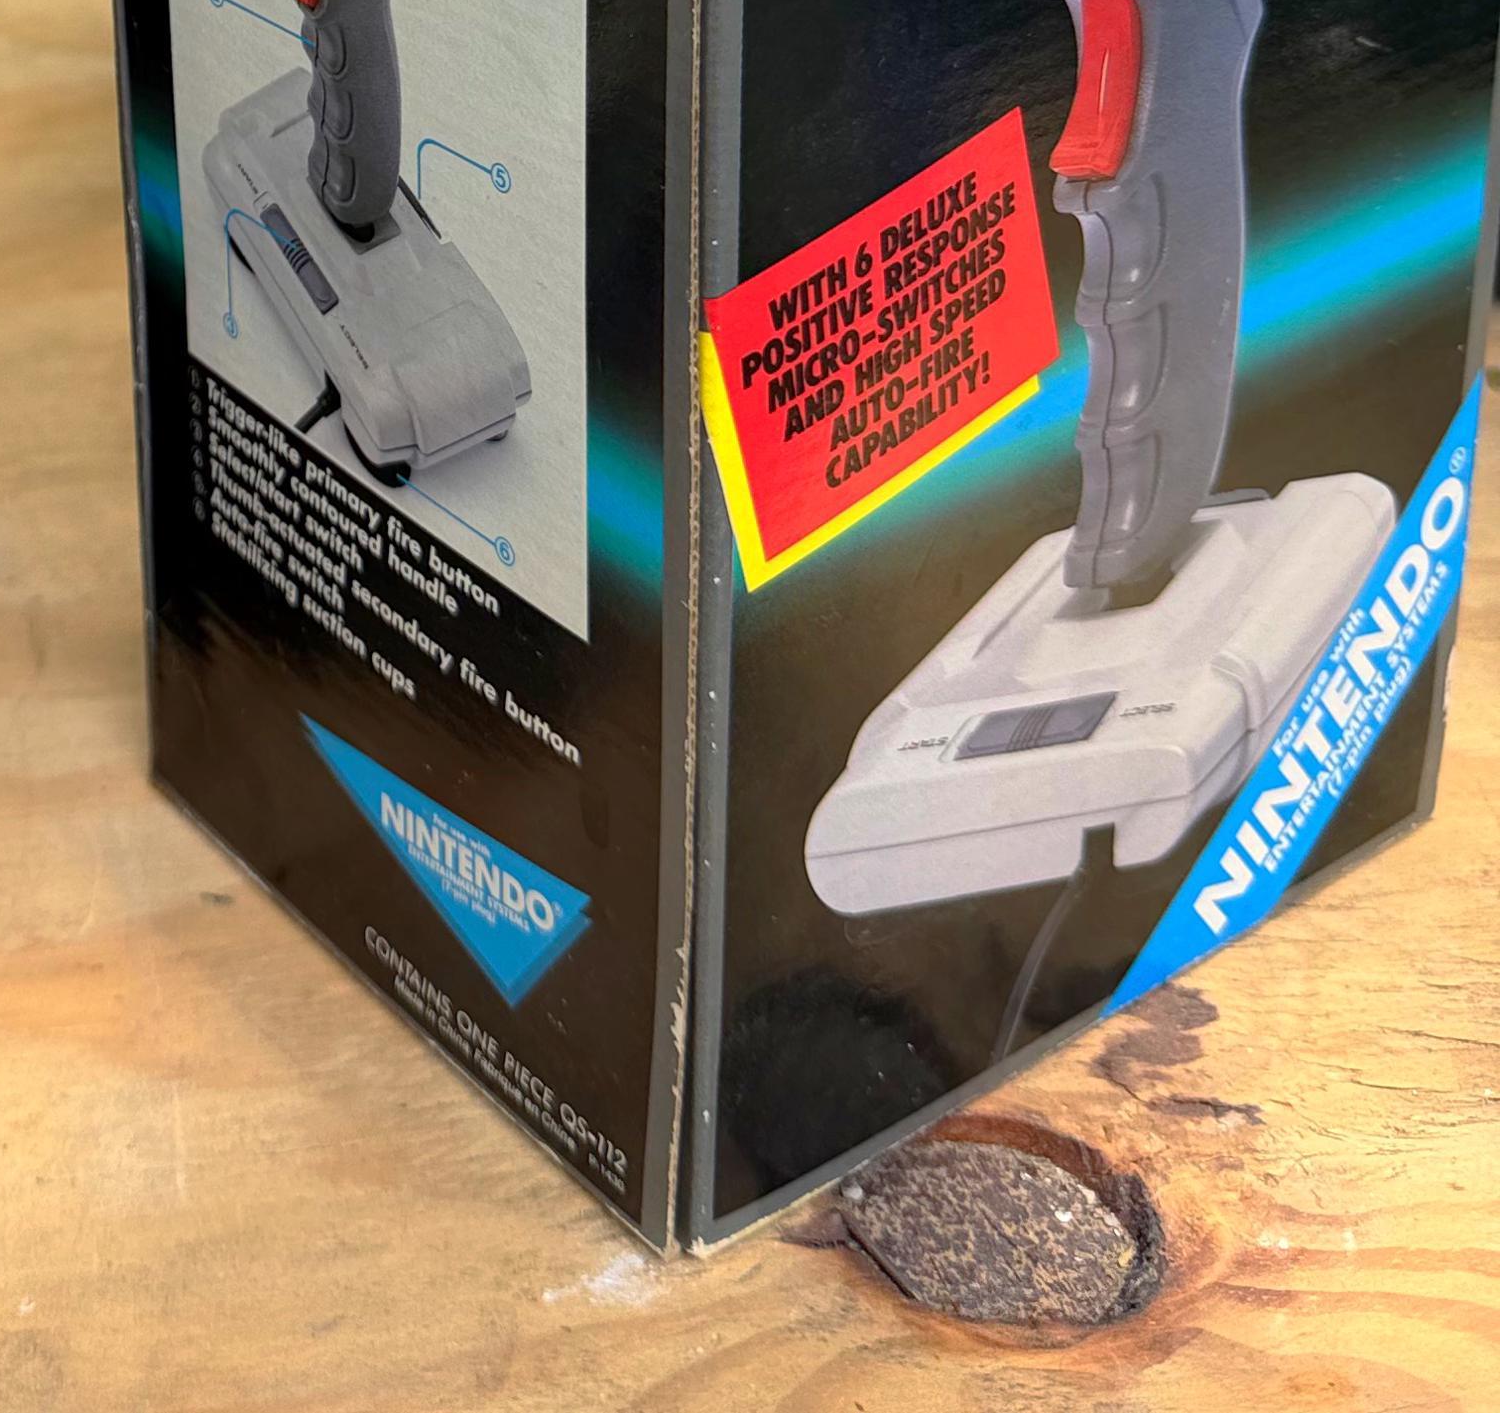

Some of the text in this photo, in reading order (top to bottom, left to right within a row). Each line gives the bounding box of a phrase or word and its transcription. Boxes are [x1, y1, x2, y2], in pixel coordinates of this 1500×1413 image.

[741, 182, 1015, 390] POSITIVE RESPONSE
[767, 170, 977, 332] WITH 6 DELUXE
[767, 229, 1006, 414] MICRO-SWITCHES
[784, 268, 1006, 442] AND HIGH SPEED
[826, 350, 990, 489] CAPABILITY!
[829, 326, 975, 451] AUTO-FIRE
[207, 377, 301, 468] Trigger-like
[305, 459, 381, 533] primary
[388, 516, 423, 564] fire
[428, 545, 500, 617] button
[208, 405, 287, 486] Smoothly
[291, 476, 383, 560] contoured
[388, 546, 460, 617] handle
[209, 431, 302, 525] Select/start
[305, 515, 364, 574] switch
[210, 487, 284, 563] Auto-fire
[288, 554, 345, 615] switch
[210, 457, 347, 588] Thumb-actuated
[352, 579, 455, 676] secondary
[460, 657, 499, 707] fire
[505, 689, 583, 768] button
[211, 511, 299, 609] Stabilizing
[303, 593, 367, 662] suction
[372, 651, 417, 701] cups
[1271, 607, 1366, 758] For use with
[1261, 560, 1449, 874] ENTERTAINMENT SYSTEMS
[1325, 656, 1412, 798] (7-pin plug)
[365, 926, 453, 1020] CONTAINS
[457, 1010, 500, 1064] ONE
[504, 1051, 555, 1110] PIECE
[560, 1102, 628, 1178] QS-112
